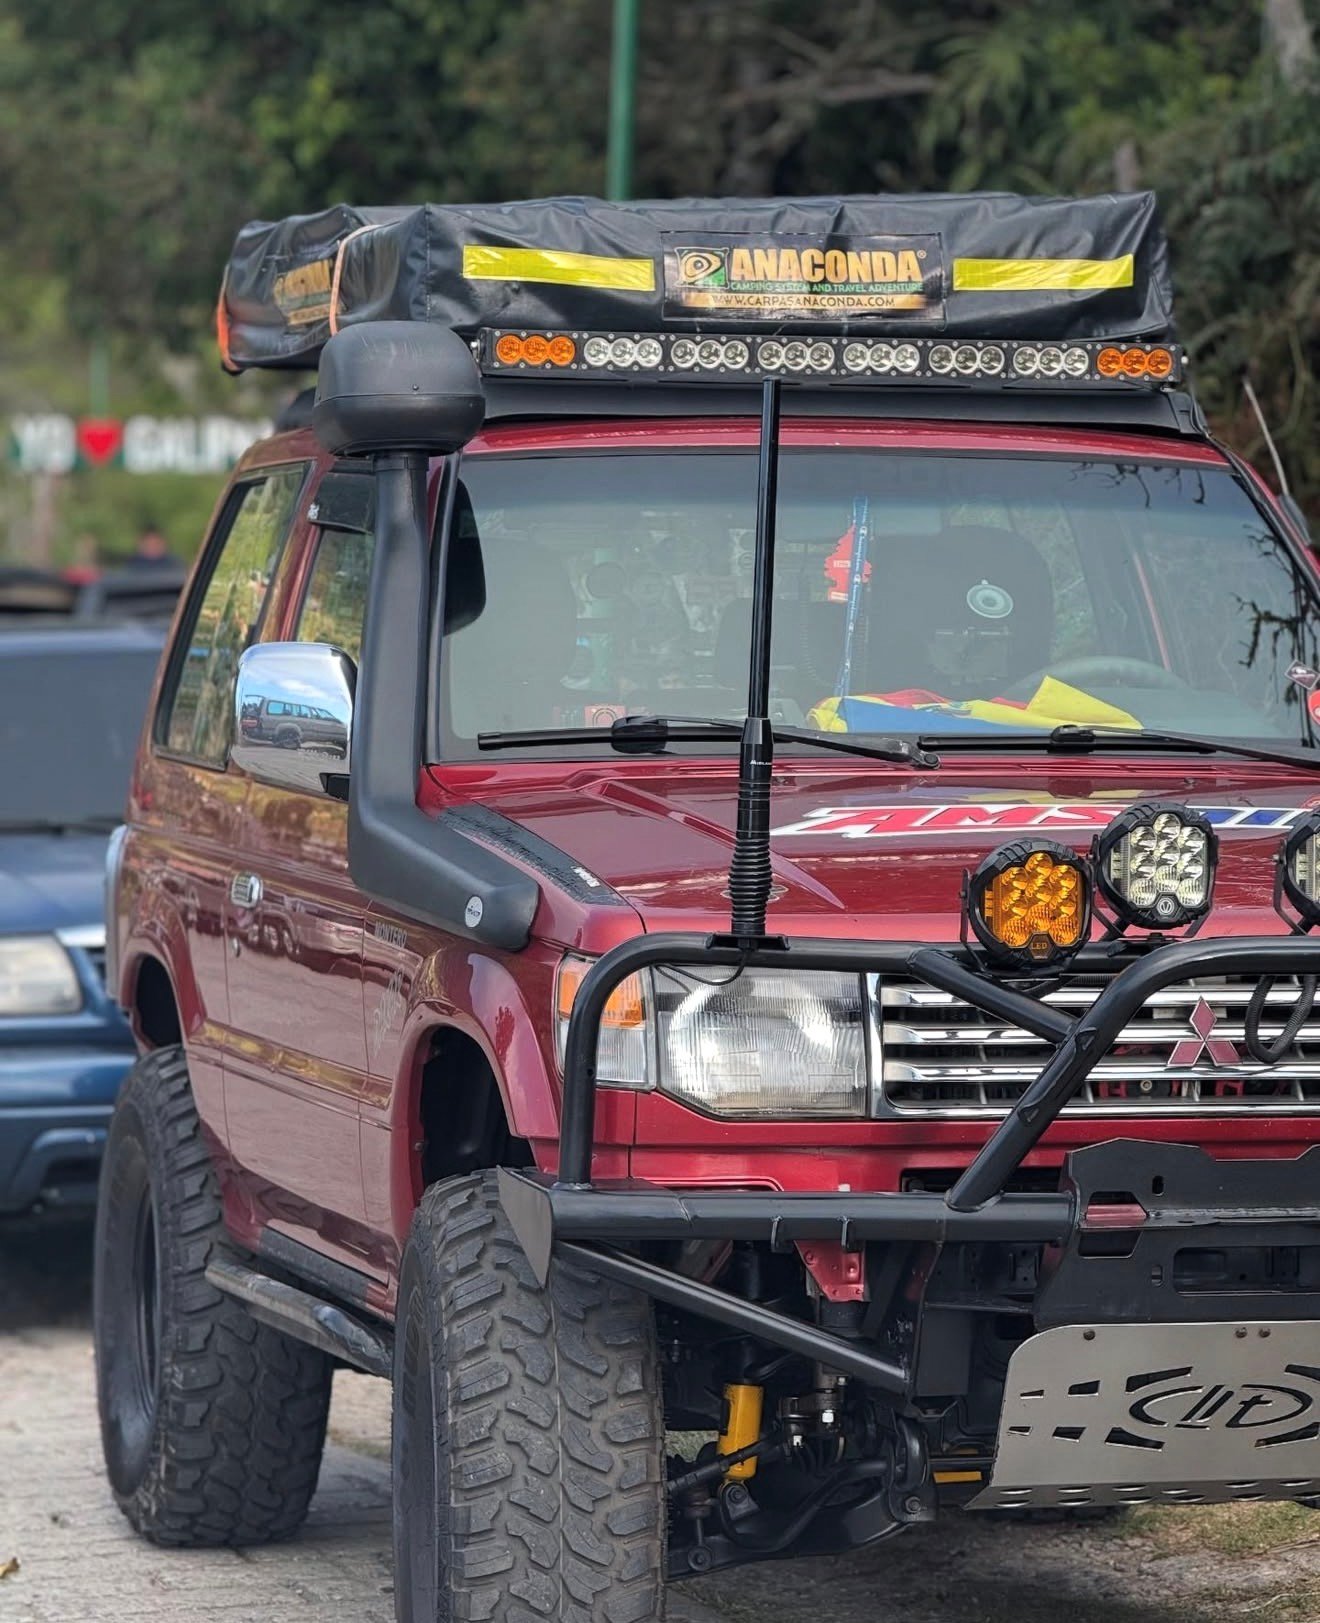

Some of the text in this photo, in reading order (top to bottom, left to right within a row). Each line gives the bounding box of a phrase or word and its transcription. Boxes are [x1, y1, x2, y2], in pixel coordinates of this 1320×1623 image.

[812, 283, 831, 293] AND
[833, 283, 866, 293] TRAVEL
[869, 282, 924, 293] ADVENTURE
[1031, 942, 1048, 950] LED
